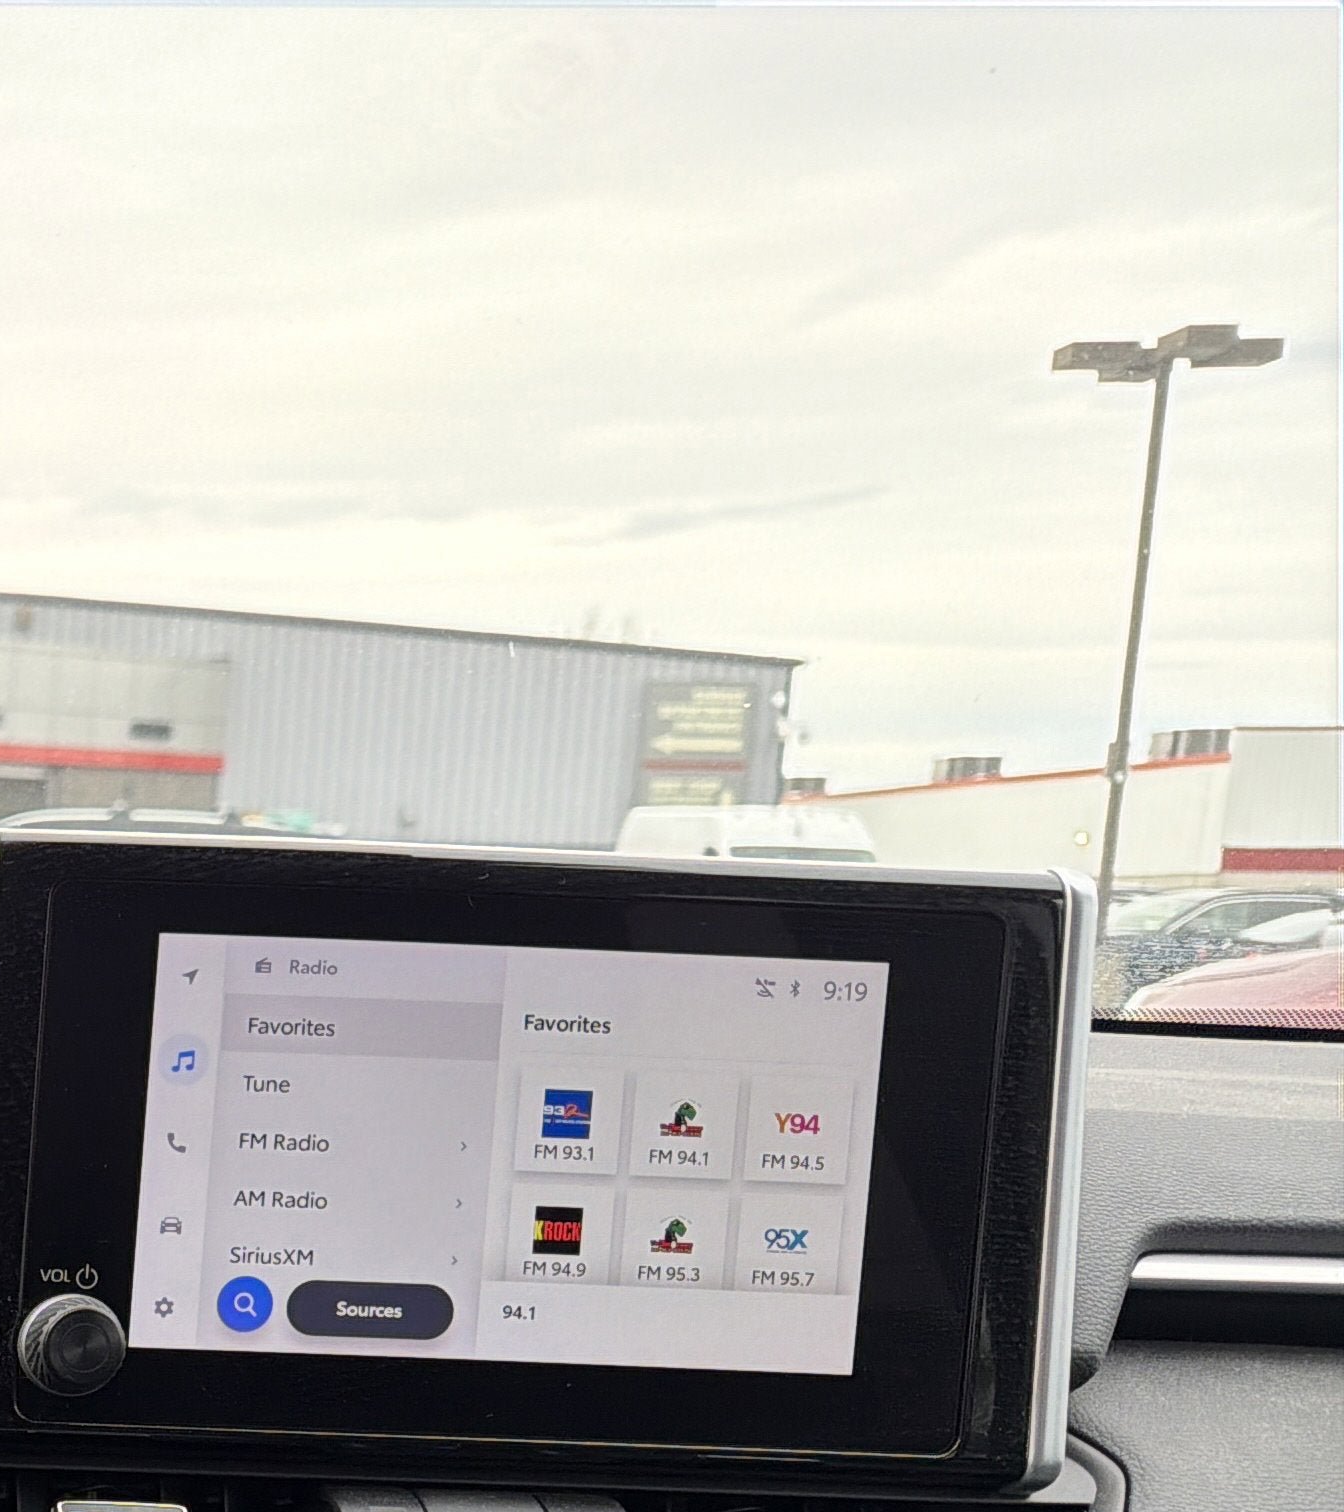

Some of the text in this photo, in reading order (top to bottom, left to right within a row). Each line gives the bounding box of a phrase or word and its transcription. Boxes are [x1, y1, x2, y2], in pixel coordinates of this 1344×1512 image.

[289, 959, 338, 976] Radio
[824, 981, 868, 1002] 9:19
[248, 1017, 335, 1037] Favorites
[524, 1014, 611, 1034] Favorites
[243, 1075, 290, 1093] Tune
[774, 1112, 821, 1135] Y94
[239, 1132, 330, 1153] FM Radio
[534, 1144, 595, 1161] FM 93.1
[649, 1149, 709, 1167] FM 94.1
[762, 1153, 825, 1171] FM 94.5
[233, 1190, 328, 1210] AM Radio
[533, 1220, 582, 1242] KROCK
[764, 1228, 809, 1251] 95X
[229, 1246, 314, 1267] SiriusXM
[40, 1268, 71, 1283] VOL
[522, 1261, 586, 1278] FM 94.9
[637, 1266, 700, 1282] FM 95.3
[752, 1270, 814, 1287] FM 95.7
[335, 1300, 403, 1319] Sources
[502, 1304, 536, 1321] 94.1
